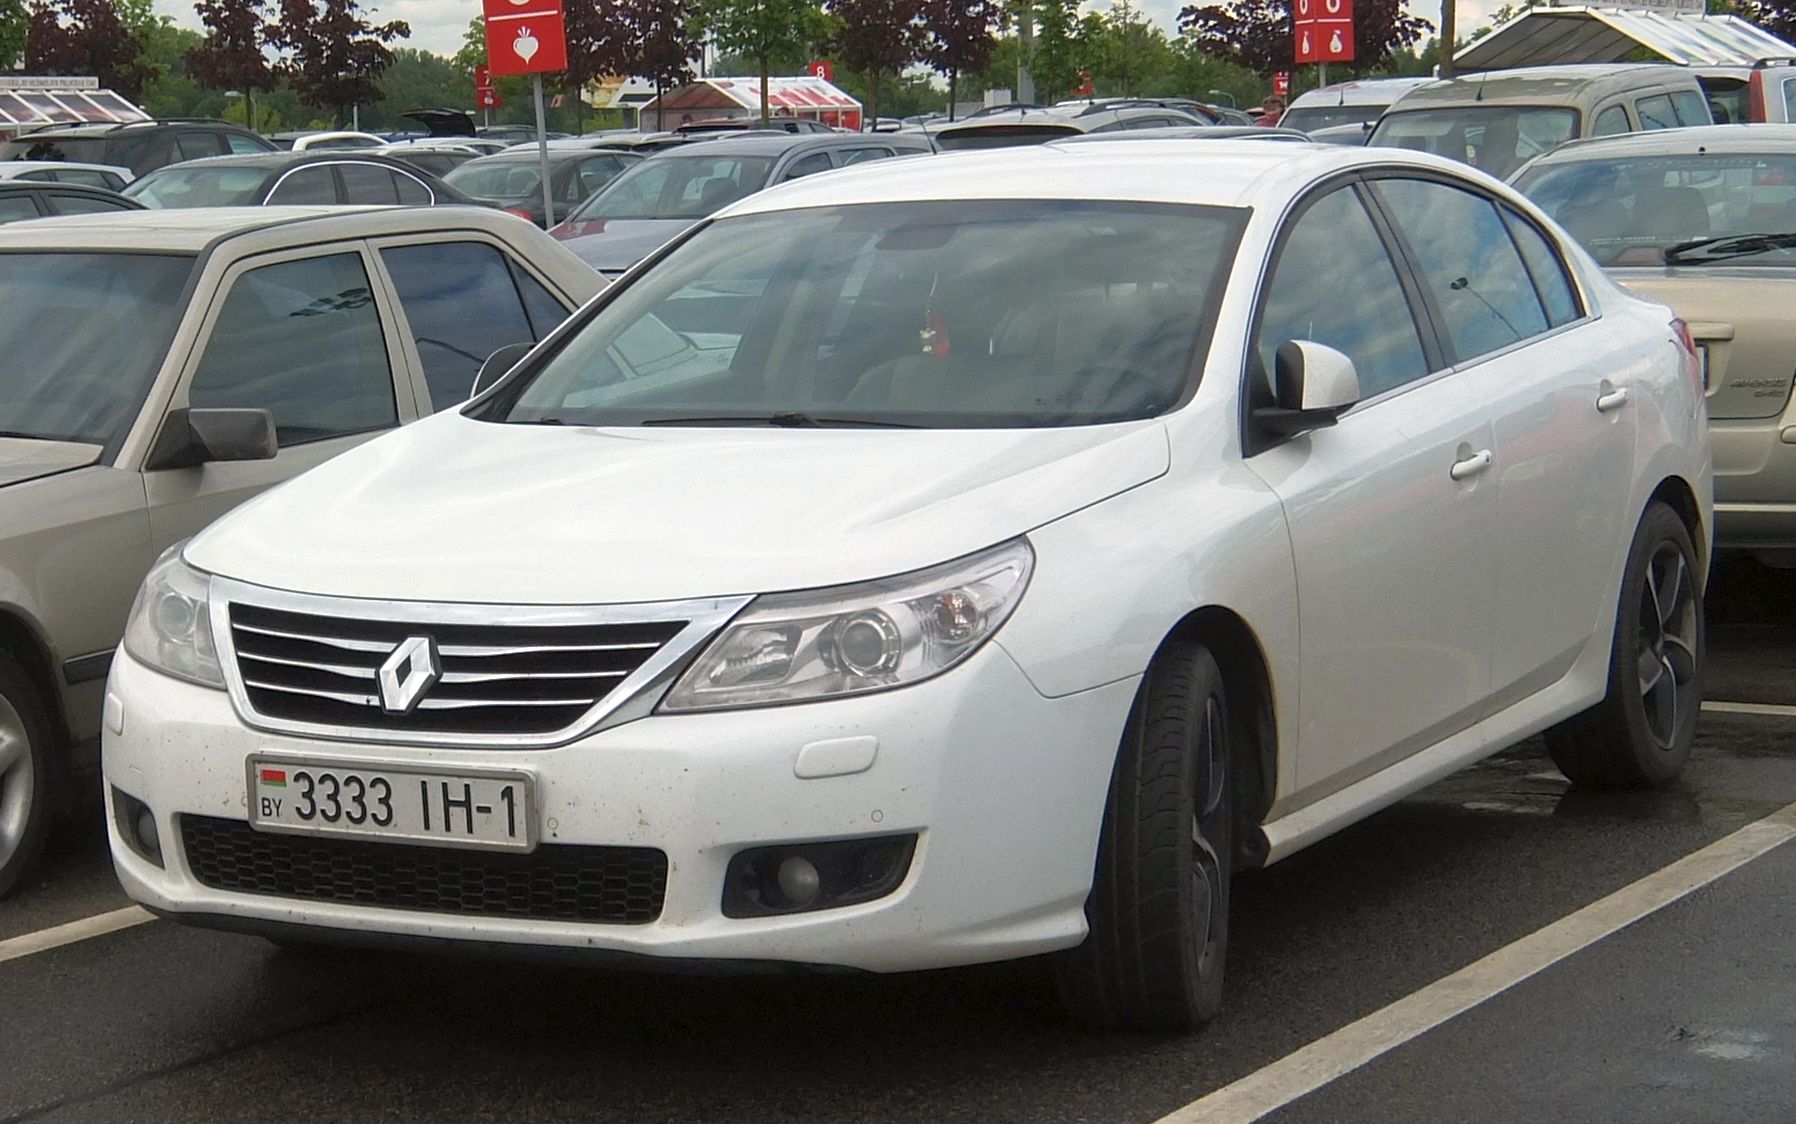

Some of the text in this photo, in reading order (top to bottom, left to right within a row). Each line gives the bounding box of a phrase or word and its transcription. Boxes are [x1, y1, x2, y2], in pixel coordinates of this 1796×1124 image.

[817, 66, 825, 78] 8
[261, 797, 283, 818] BY
[293, 772, 515, 837] 3333 IH-1
